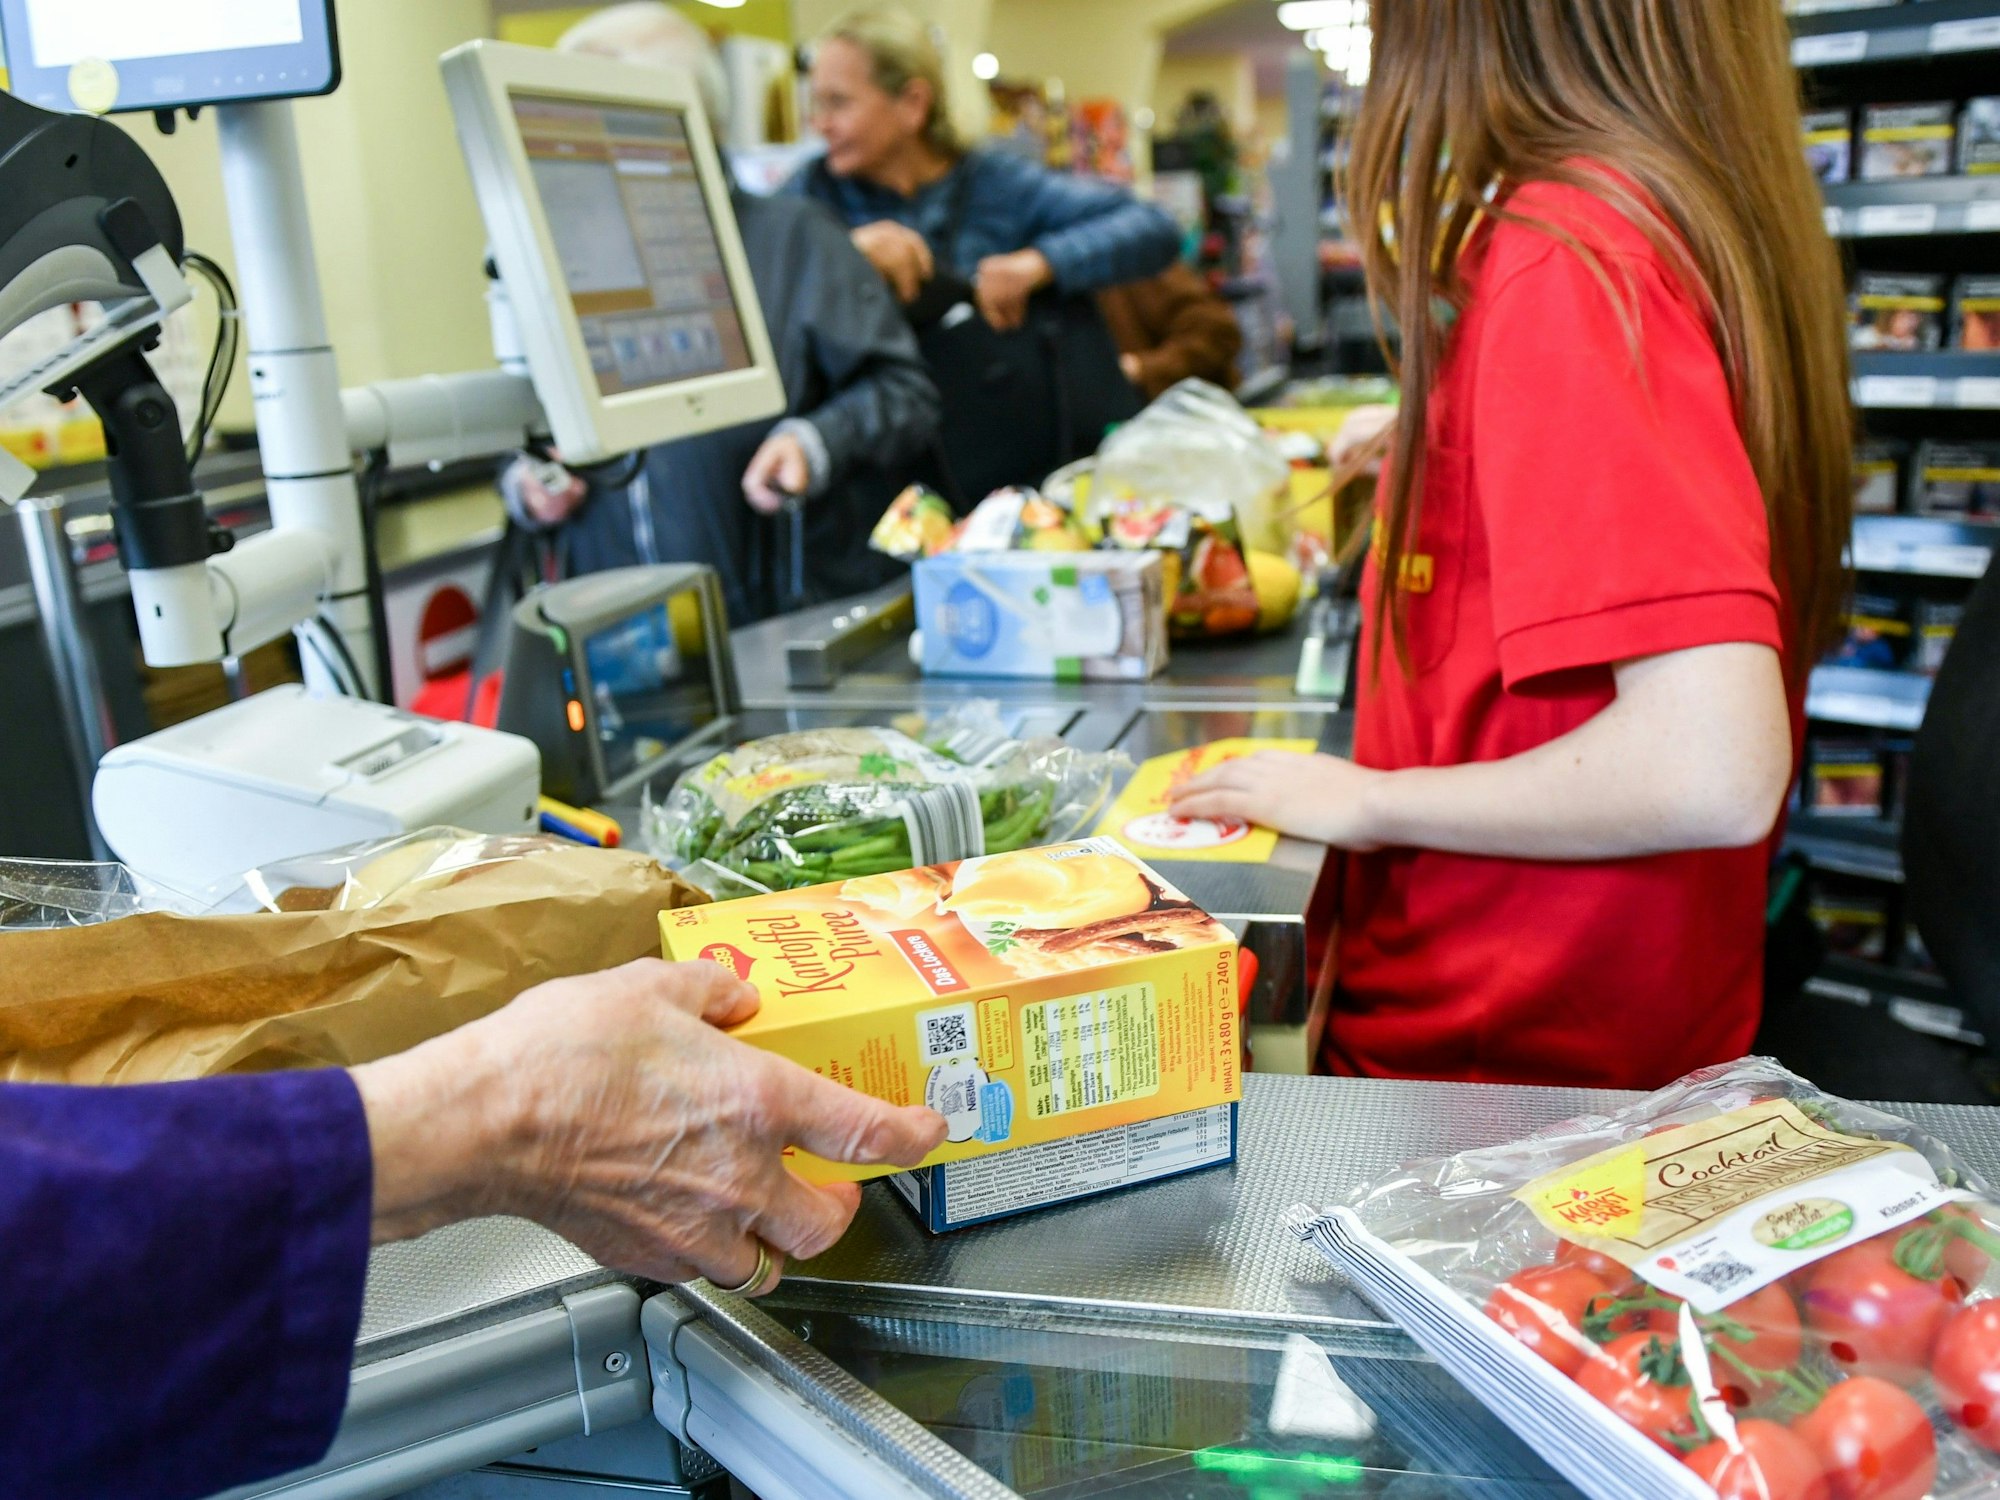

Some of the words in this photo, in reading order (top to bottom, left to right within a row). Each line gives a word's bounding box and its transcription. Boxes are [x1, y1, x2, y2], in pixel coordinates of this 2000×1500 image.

[672, 911, 698, 927] 3x3
[821, 911, 882, 961] Püree
[747, 914, 854, 997] Kartoffel
[907, 934, 942, 967] Lockere
[1219, 950, 1231, 959] g
[931, 967, 957, 986] Das
[1217, 961, 1229, 985] 240
[984, 1003, 992, 1044] KOCHSTUDIO
[1221, 1011, 1233, 1020] g
[1219, 1021, 1231, 1038] 80
[1220, 1047, 1232, 1056] 3
[1223, 1057, 1233, 1093] INHALT:
[1658, 1131, 1792, 1188] Cocktail
[1559, 1192, 1628, 1224] MARKT
[1879, 1197, 1916, 1218] Klasse
